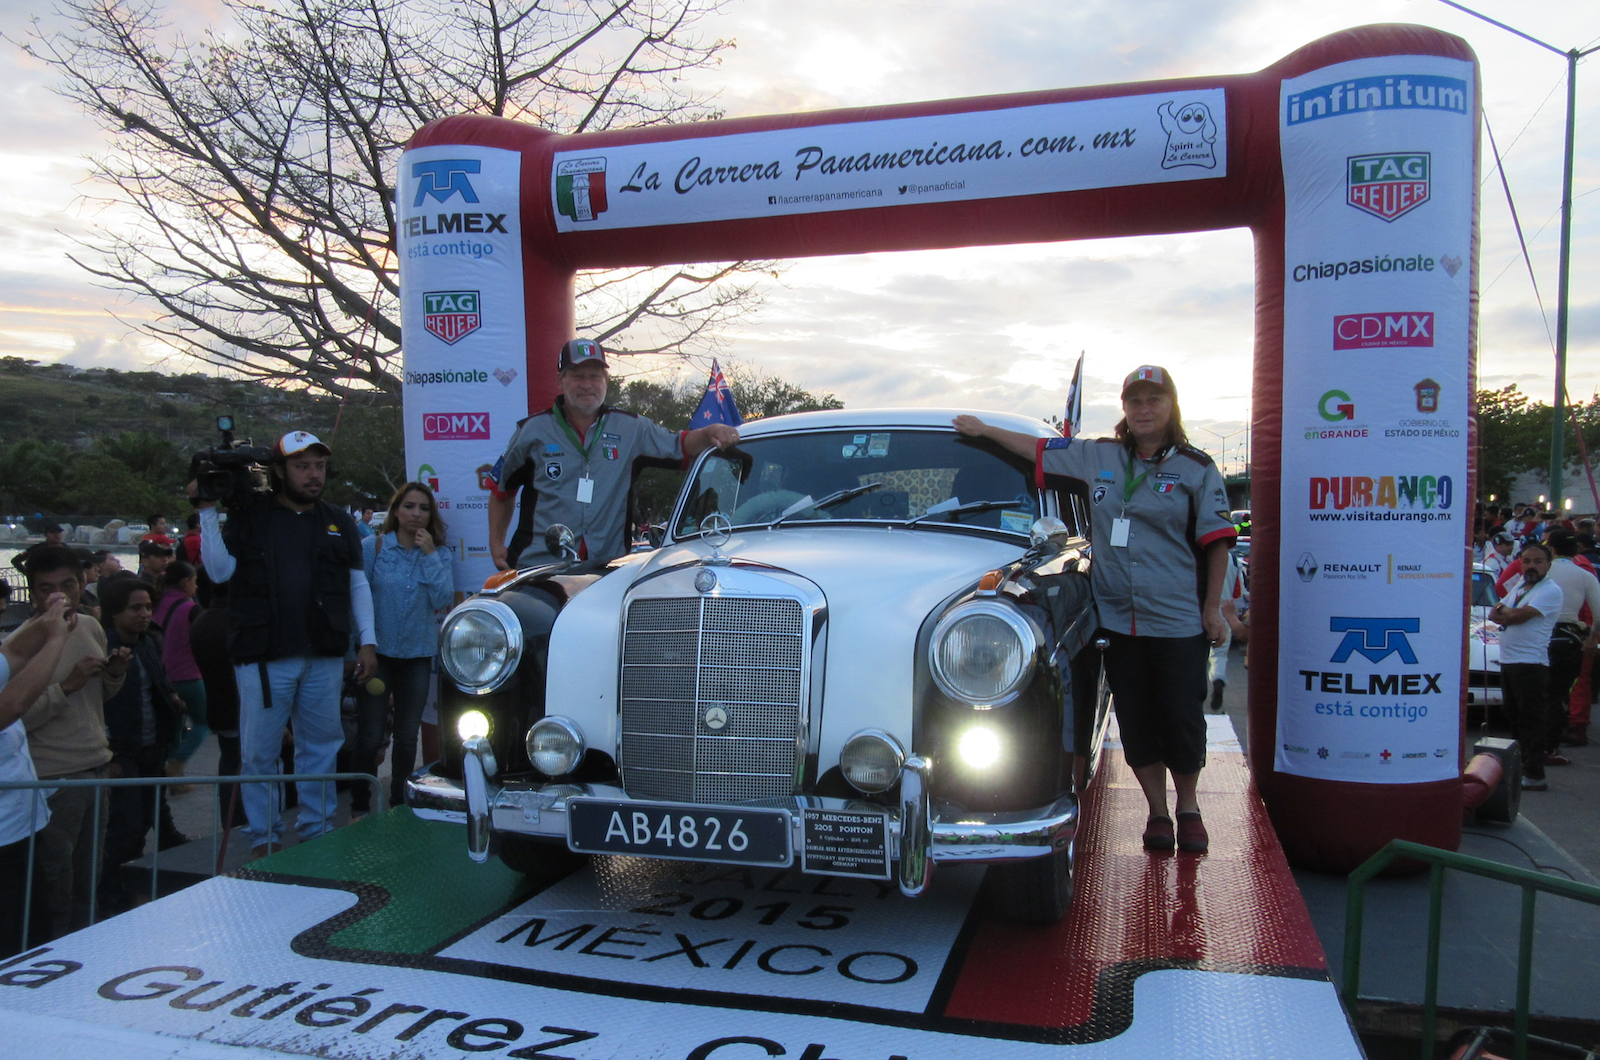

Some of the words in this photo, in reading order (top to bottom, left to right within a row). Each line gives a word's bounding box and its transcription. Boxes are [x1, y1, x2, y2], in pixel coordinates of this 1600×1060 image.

[1291, 79, 1465, 122] infinitum
[1166, 153, 1178, 162] La
[1180, 152, 1210, 161] Carrera
[1169, 142, 1194, 152] Spirit
[560, 167, 604, 175] Panamericana
[564, 161, 573, 169] La
[574, 160, 600, 168] Carrera
[1355, 158, 1424, 181] TAG
[619, 161, 662, 193] La
[674, 156, 783, 195] Carrera
[908, 180, 966, 196] @panaoficial
[1353, 183, 1425, 217] HEUER
[401, 212, 508, 240] TELMEX
[408, 243, 429, 260] está
[432, 239, 494, 260] contigo
[1292, 254, 1436, 283] Chiapasiónate
[426, 293, 474, 313] TAG
[426, 315, 477, 338] HEUER
[1336, 315, 1431, 341] CDMX
[405, 367, 489, 387] Chiapasiónate
[424, 415, 487, 434] CDMX
[1384, 429, 1419, 438] ESTADO
[1421, 429, 1433, 437] DE
[1433, 428, 1459, 438] MÉXICO
[1399, 419, 1437, 428] GOBIERNO
[1304, 429, 1369, 440] enGRANDE
[1309, 475, 1453, 510] DURANGO
[1309, 511, 1452, 523] www.visitadurango.mx
[1323, 564, 1381, 572] RENAULT
[1298, 670, 1442, 695] TELMEX
[1314, 701, 1354, 717] está
[1360, 702, 1428, 722] contigo
[822, 814, 882, 824] MERCEDES-BENZ
[605, 811, 749, 852] AB4826
[839, 826, 874, 834] PONTON
[630, 892, 856, 930] 2015
[496, 917, 919, 984] MÉXICO
[97, 965, 599, 1060] Gutiérrez
